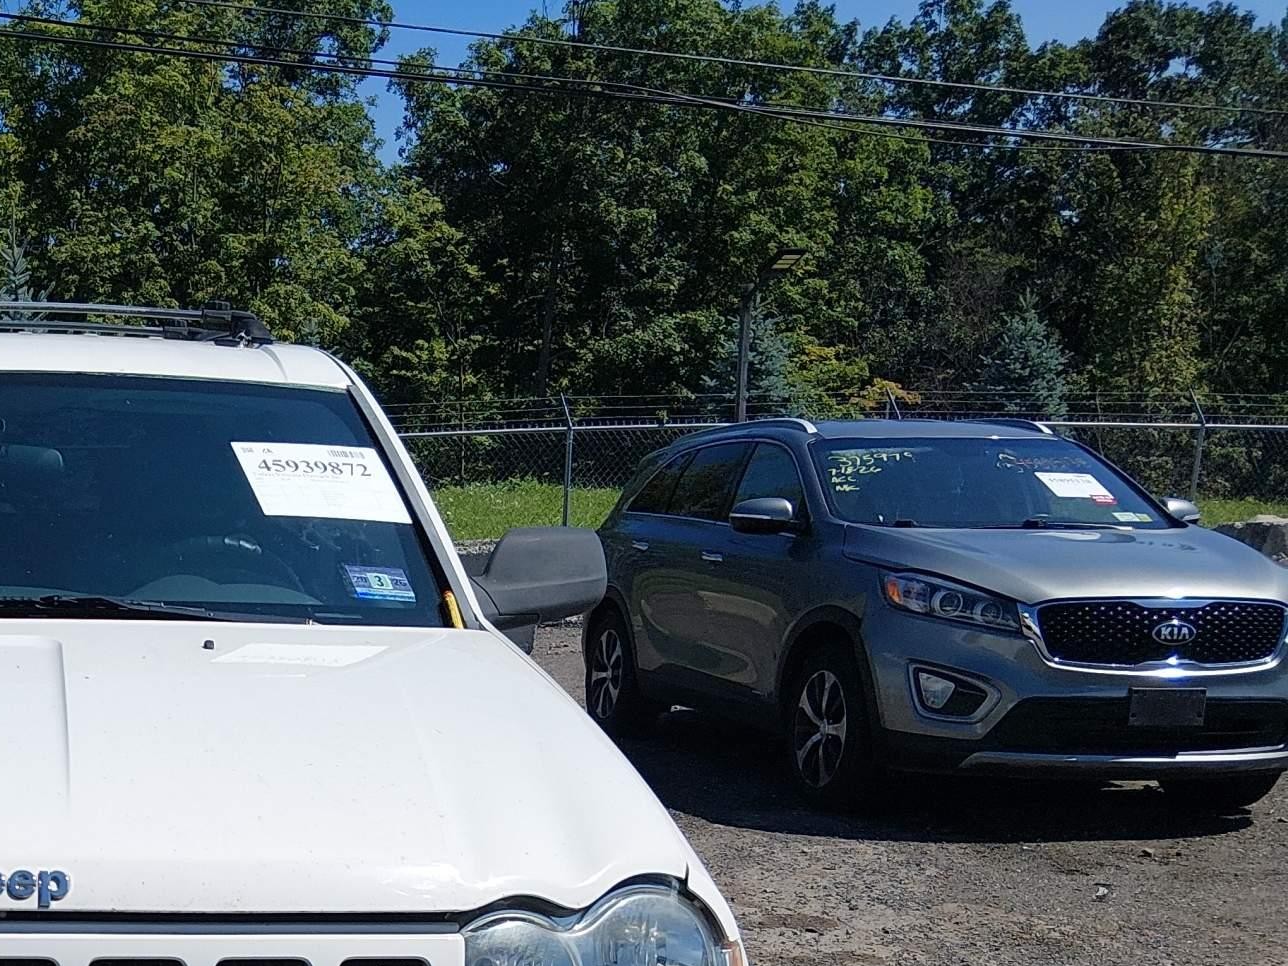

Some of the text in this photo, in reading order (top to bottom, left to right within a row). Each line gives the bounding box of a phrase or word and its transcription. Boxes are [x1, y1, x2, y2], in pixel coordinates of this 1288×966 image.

[257, 459, 372, 477] 45939872
[374, 575, 385, 587] 3
[1160, 626, 1190, 640] KIA
